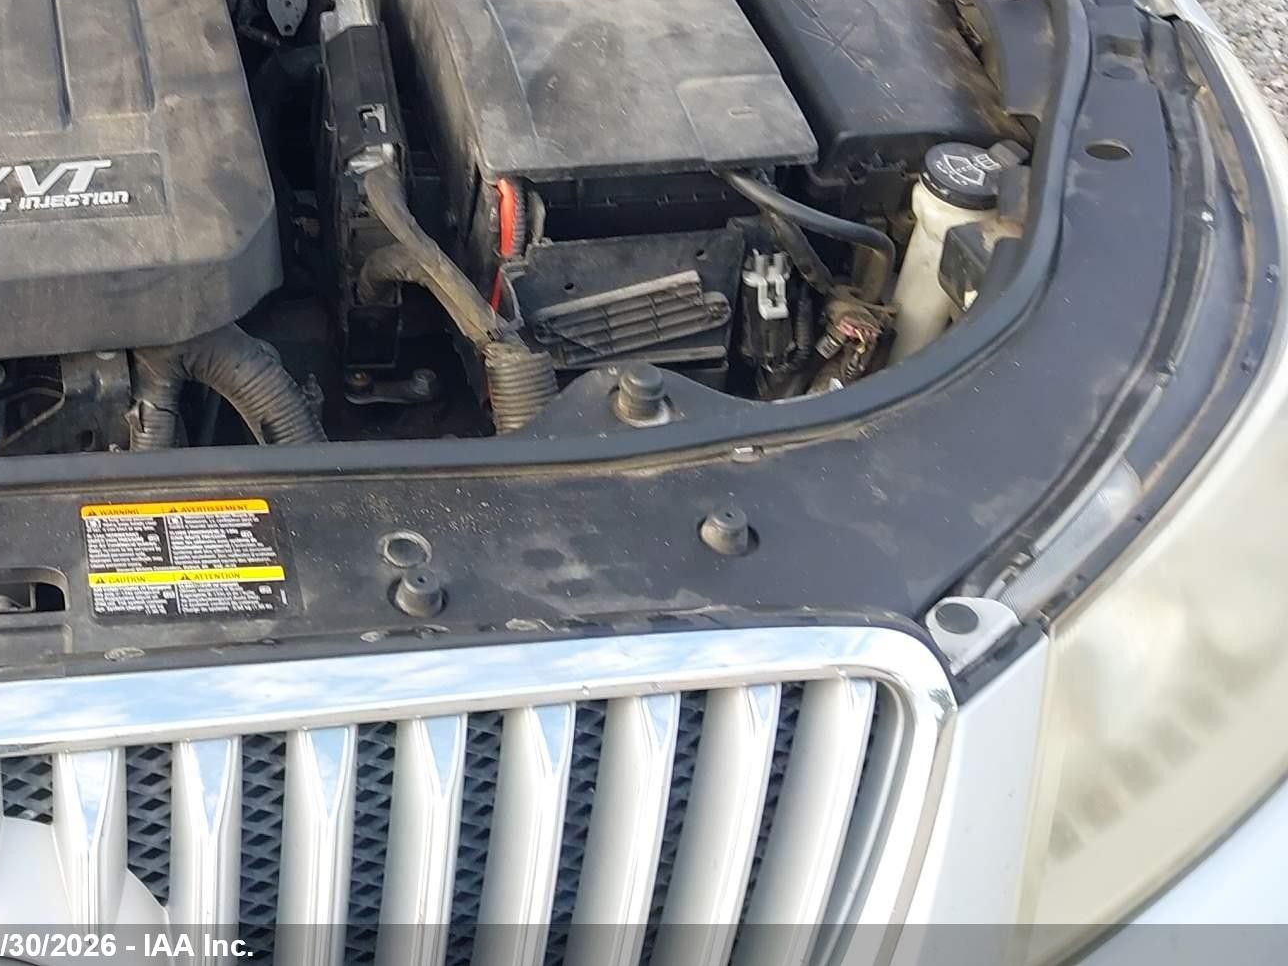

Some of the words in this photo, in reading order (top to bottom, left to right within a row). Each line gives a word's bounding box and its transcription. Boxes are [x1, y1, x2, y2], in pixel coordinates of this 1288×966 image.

[18, 190, 131, 211] INJECTION
[99, 508, 139, 516] WARNING
[180, 504, 249, 513] AVERTISSEMENT
[108, 576, 146, 584] CAUTION
[193, 572, 241, 580] ATTENTION
